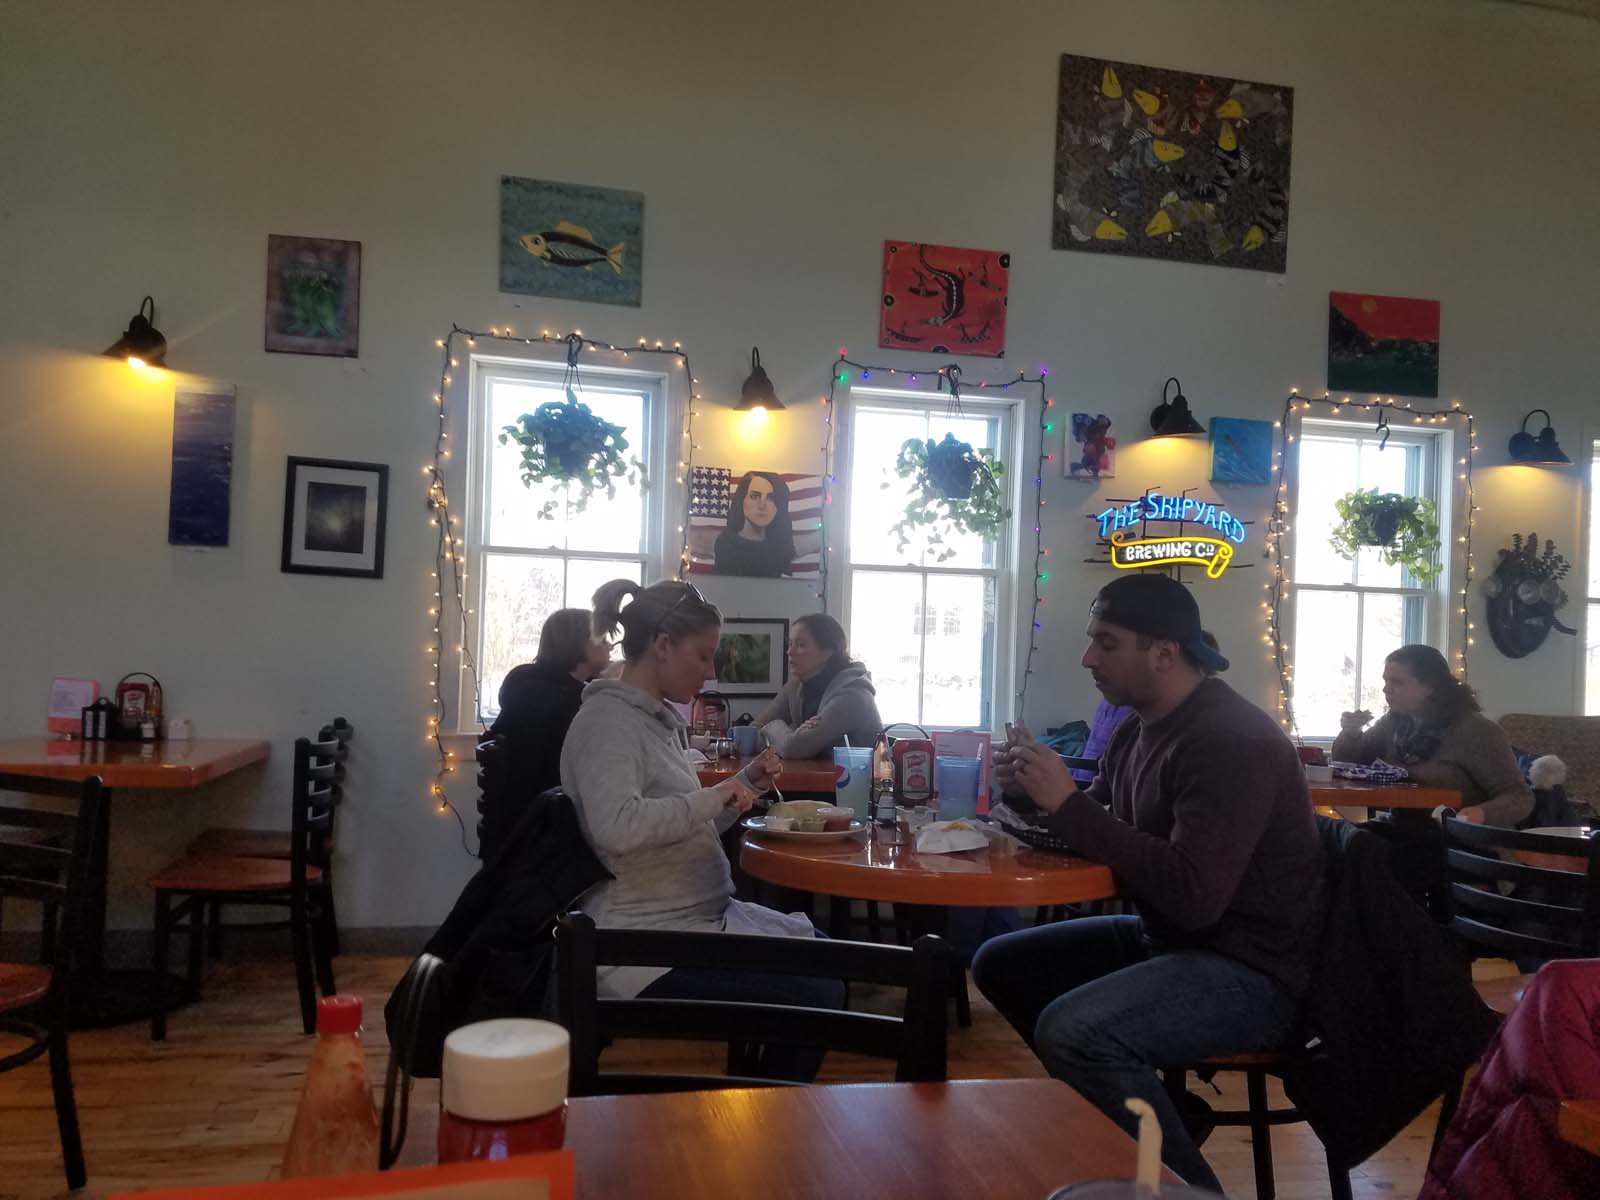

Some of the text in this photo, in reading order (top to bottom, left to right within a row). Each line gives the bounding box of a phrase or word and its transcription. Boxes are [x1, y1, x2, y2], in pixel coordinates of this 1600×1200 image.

[1097, 493, 1245, 543] THE SHIPYARD
[1126, 541, 1191, 561] BREWING
